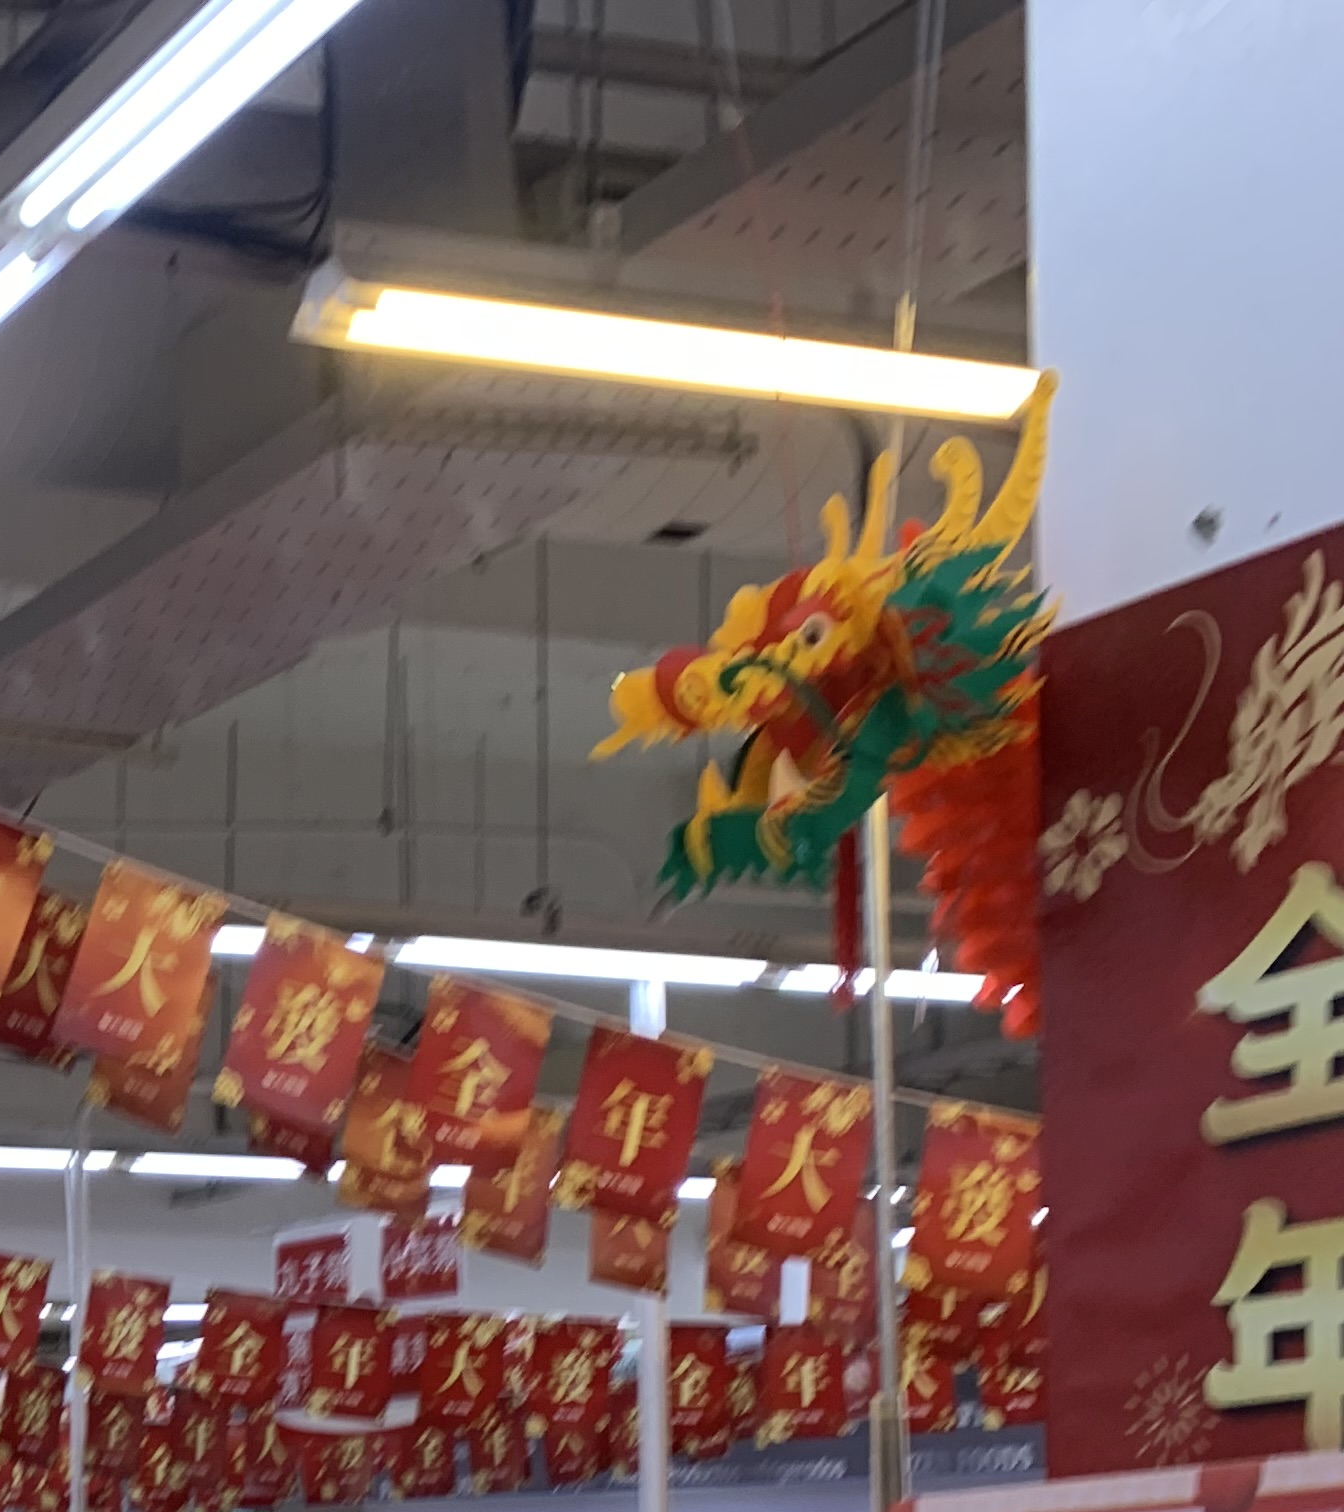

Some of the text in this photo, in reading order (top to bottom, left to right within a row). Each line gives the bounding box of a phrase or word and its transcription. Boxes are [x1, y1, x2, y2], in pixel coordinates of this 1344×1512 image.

[92, 926, 178, 1018] 大
[262, 985, 342, 1075] 發
[436, 1037, 512, 1125] 全
[601, 1078, 674, 1167] 年
[761, 1125, 841, 1212] 大
[942, 1161, 1013, 1247] 發
[100, 1304, 149, 1360] 發
[222, 1321, 265, 1377] 全
[328, 1332, 376, 1389] 年
[437, 1342, 486, 1399] 大
[548, 1346, 603, 1406] 發
[780, 1352, 828, 1407] 年
